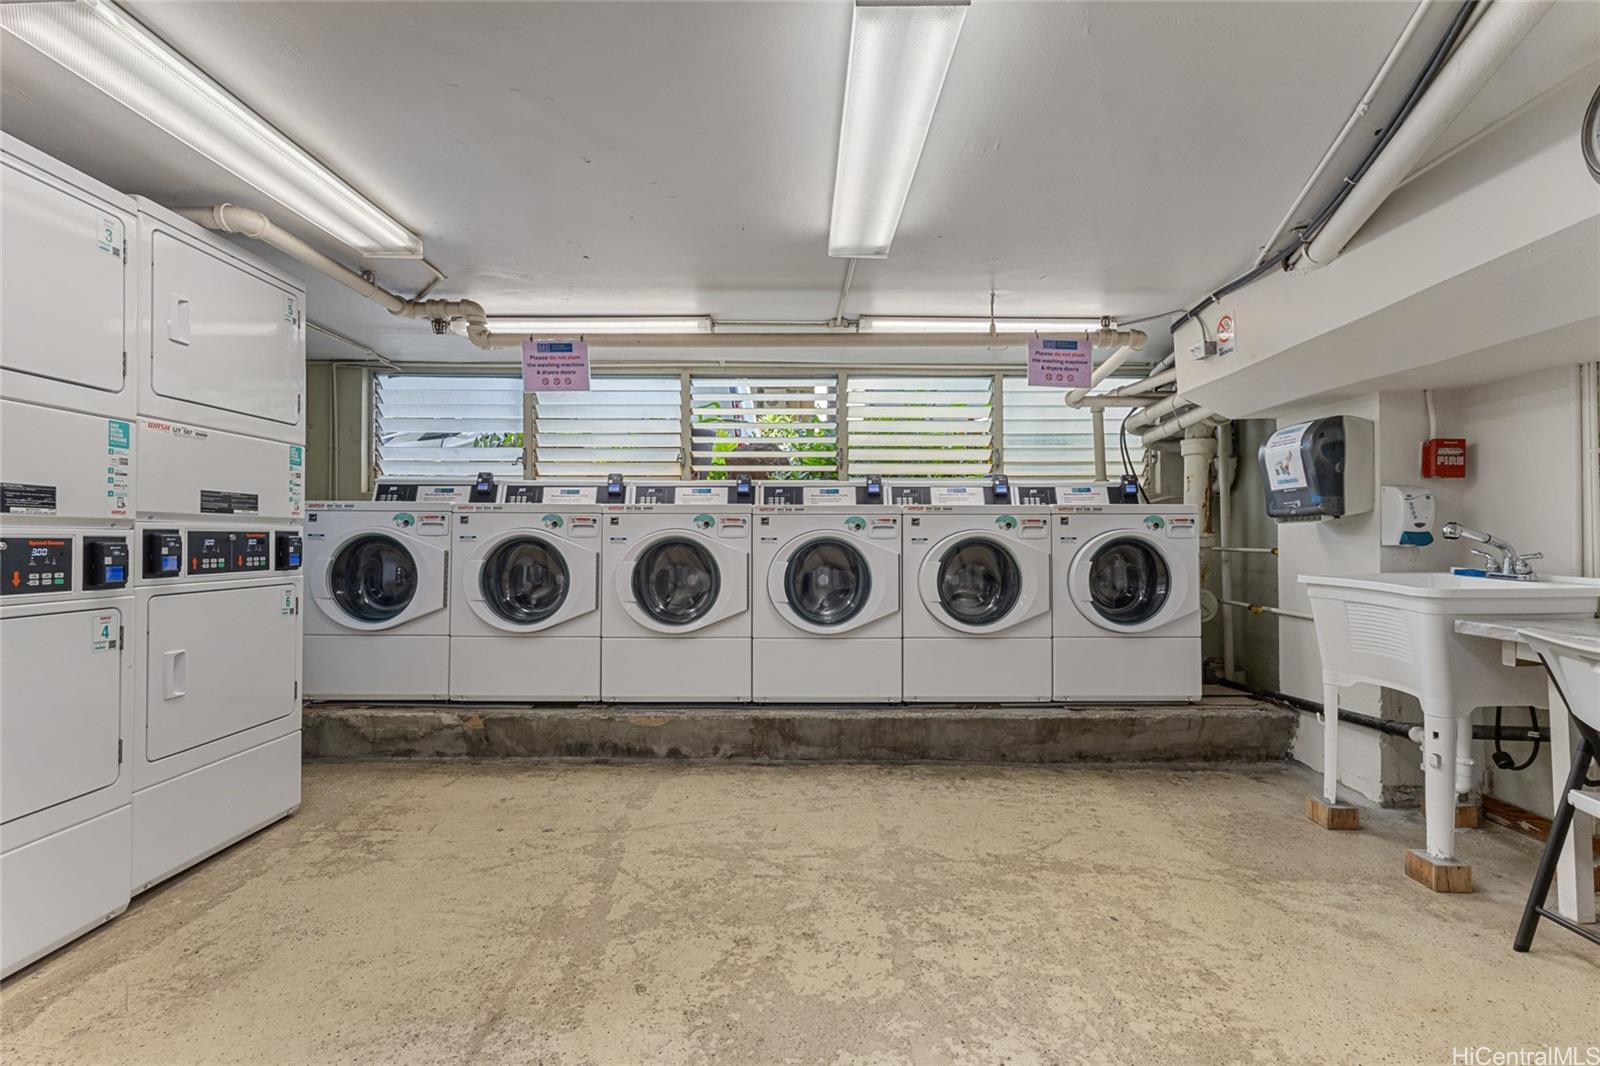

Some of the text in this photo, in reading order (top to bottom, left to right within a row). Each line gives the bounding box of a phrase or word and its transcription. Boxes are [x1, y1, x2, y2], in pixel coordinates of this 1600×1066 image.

[105, 228, 112, 243] 3
[285, 596, 291, 607] 6
[101, 624, 109, 639] 4
